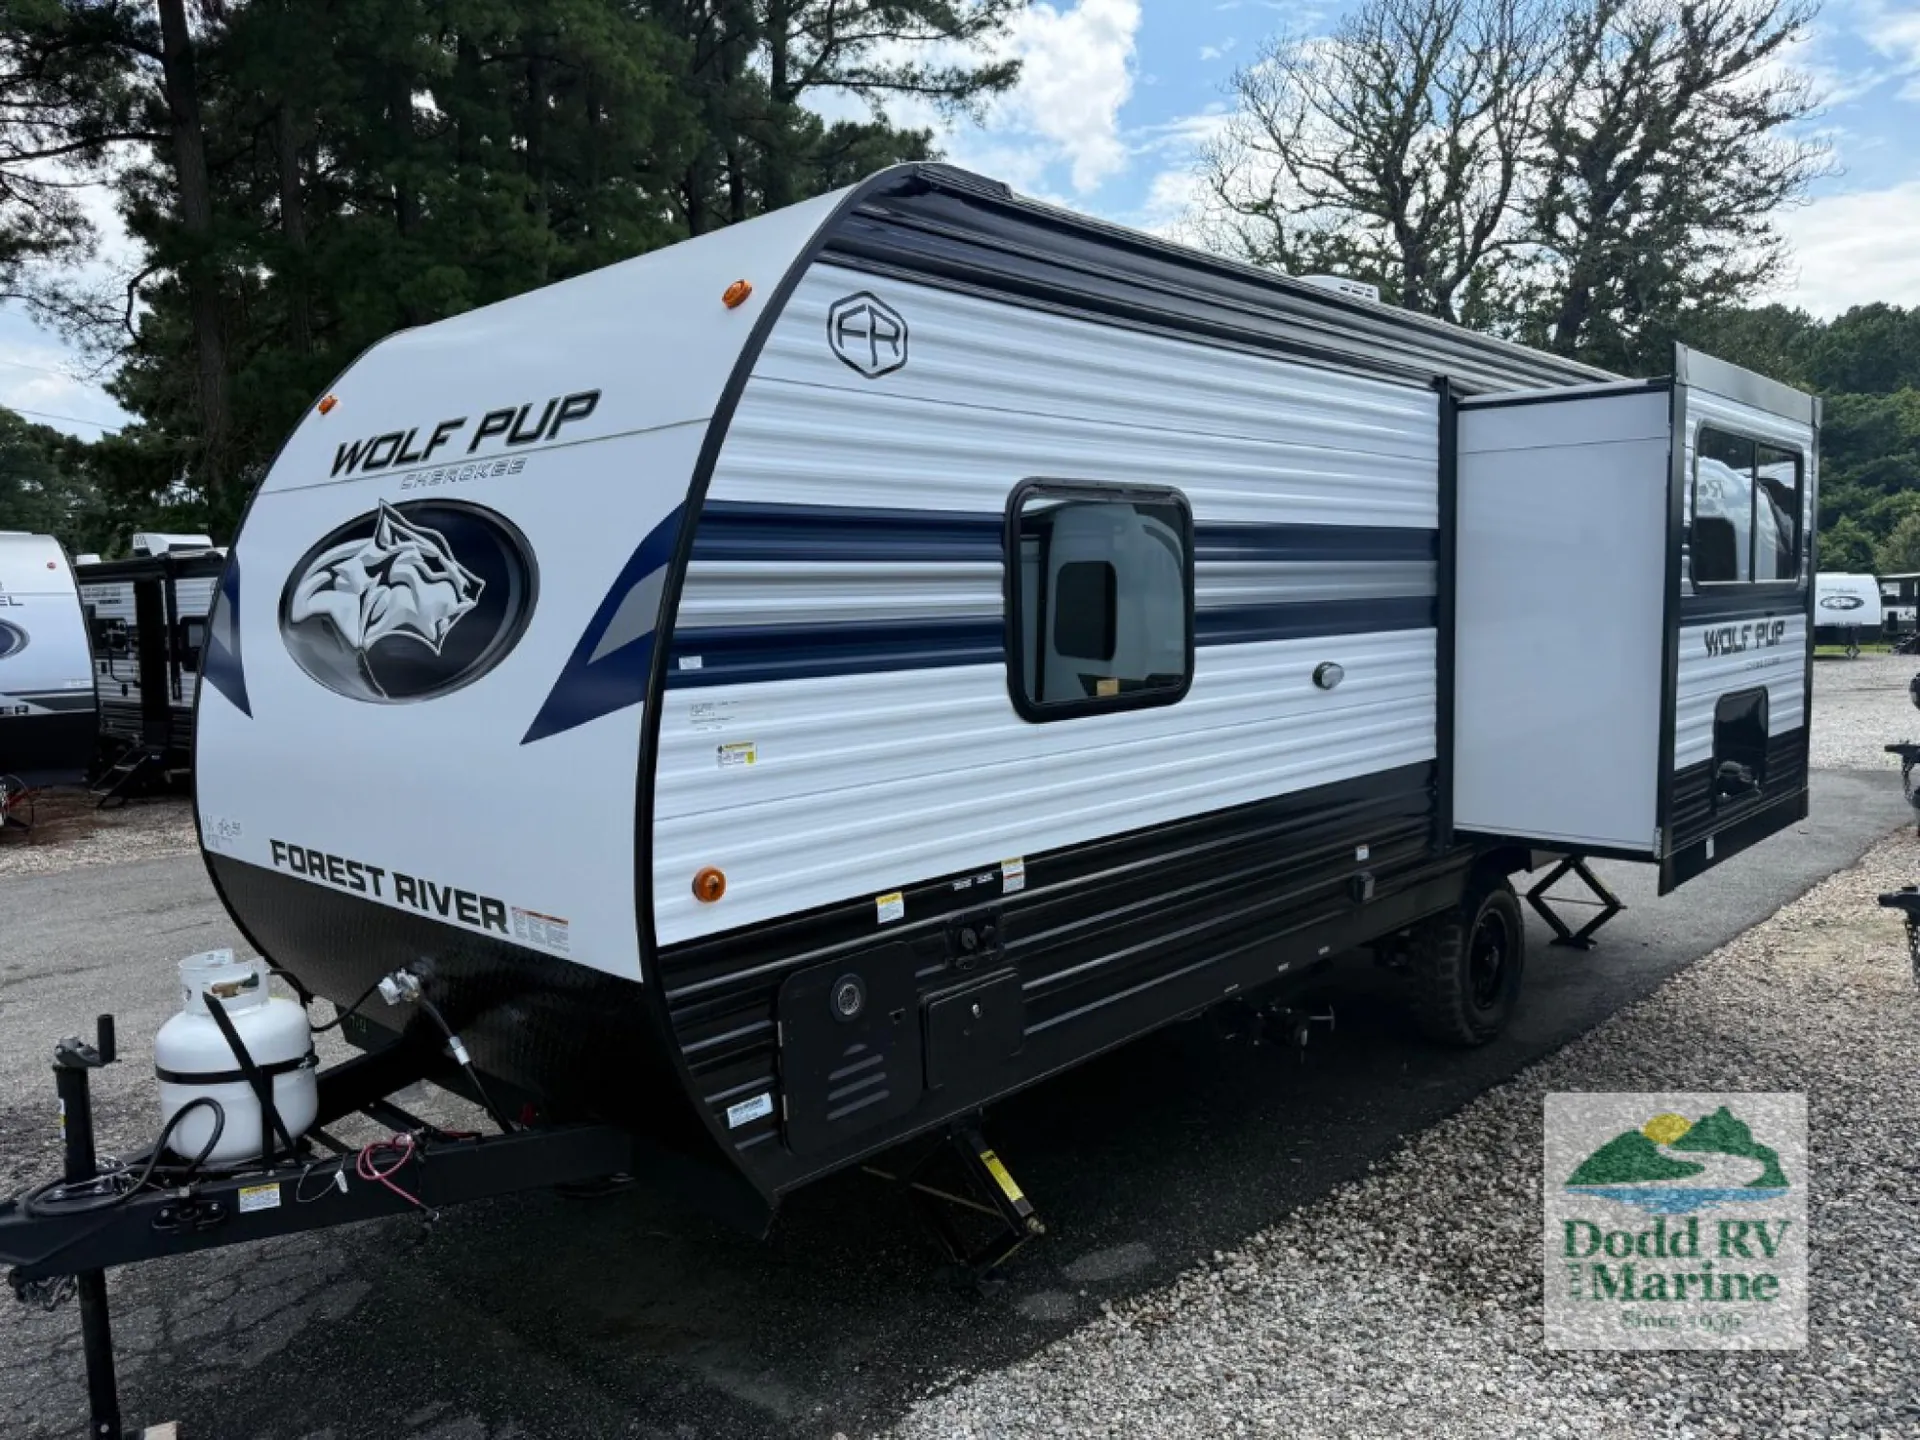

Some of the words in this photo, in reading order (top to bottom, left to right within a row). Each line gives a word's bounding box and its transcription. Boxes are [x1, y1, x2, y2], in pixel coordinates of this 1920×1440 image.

[329, 416, 468, 479] WOLF
[466, 388, 603, 455] PUP
[400, 457, 528, 490] CHEROKEE
[1704, 624, 1752, 658] WOLF
[1755, 620, 1786, 650] PUP
[269, 838, 385, 897] FOREST
[391, 871, 510, 935] RIVER
